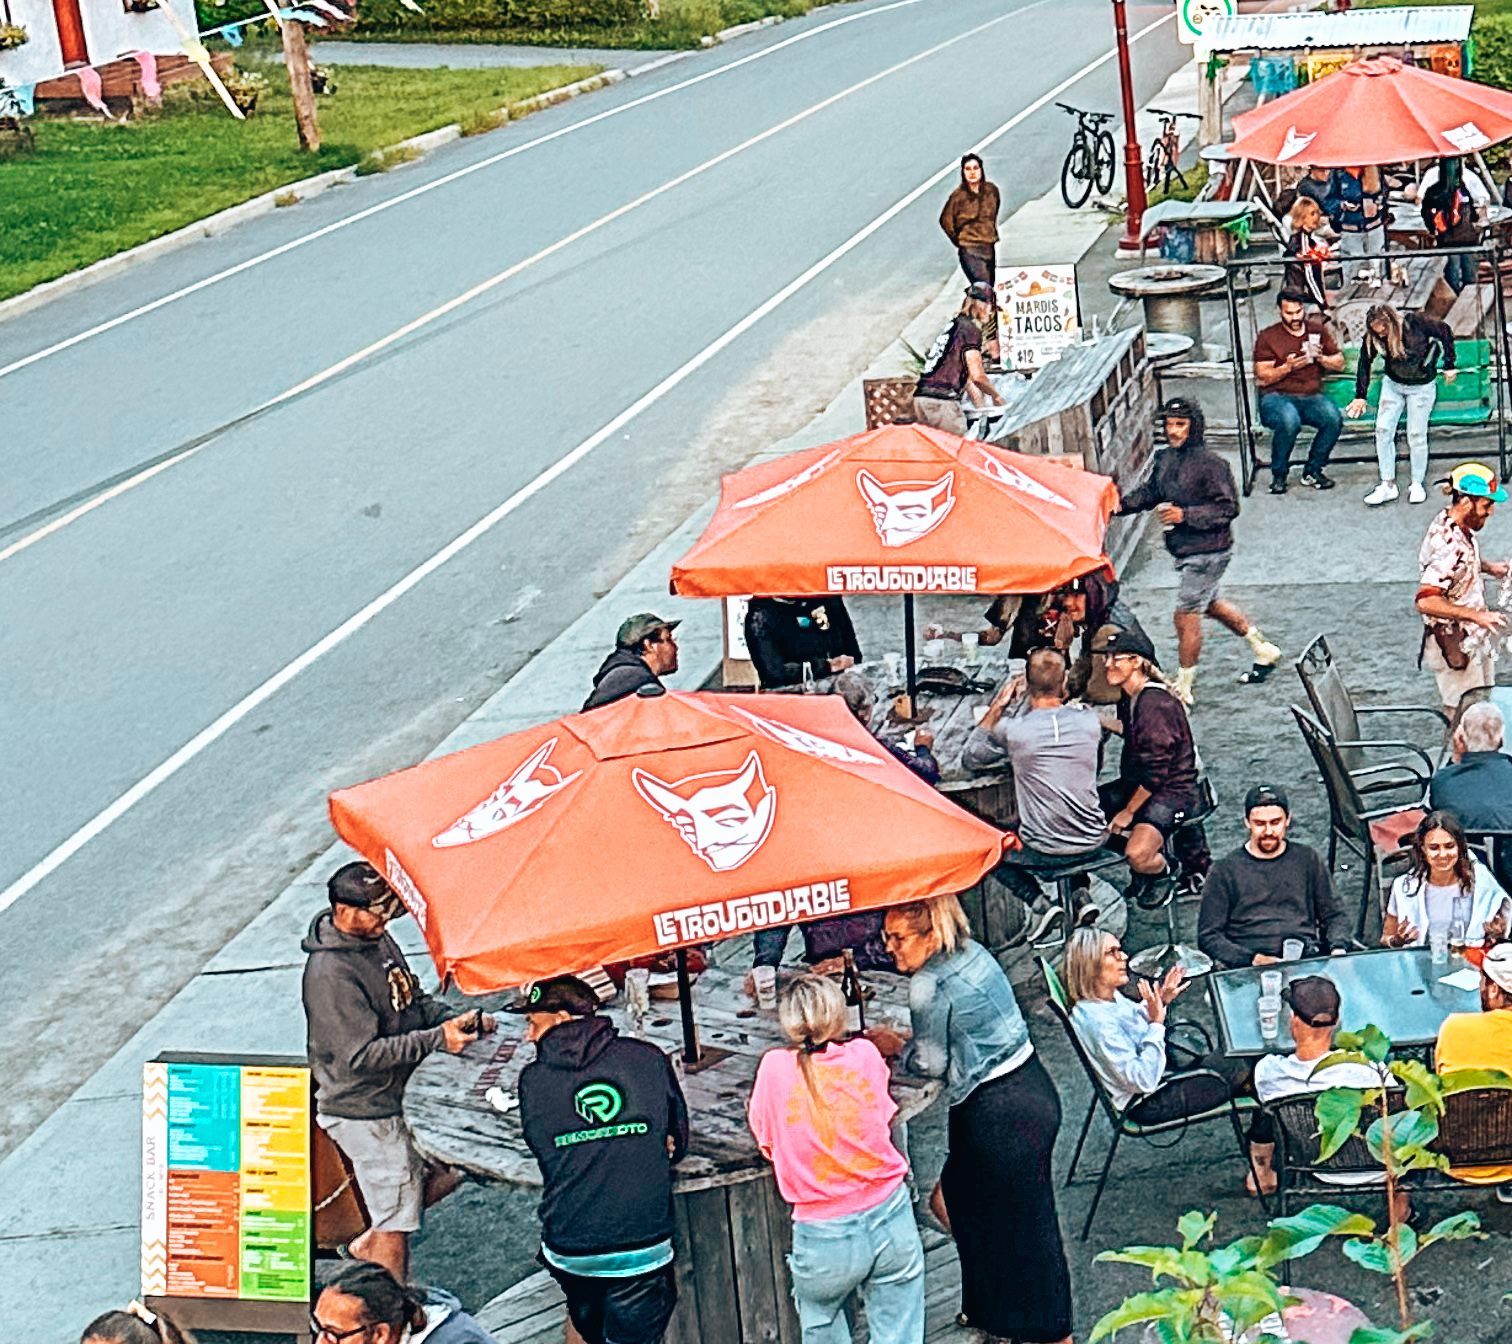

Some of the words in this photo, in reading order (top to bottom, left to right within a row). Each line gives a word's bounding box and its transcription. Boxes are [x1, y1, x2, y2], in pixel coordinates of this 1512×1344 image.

[1015, 299, 1059, 315] MARDIS
[1014, 315, 1062, 334] TACOS
[1017, 348, 1034, 364] $12
[146, 1136, 156, 1166] BAR
[146, 1171, 156, 1220] SNACK
